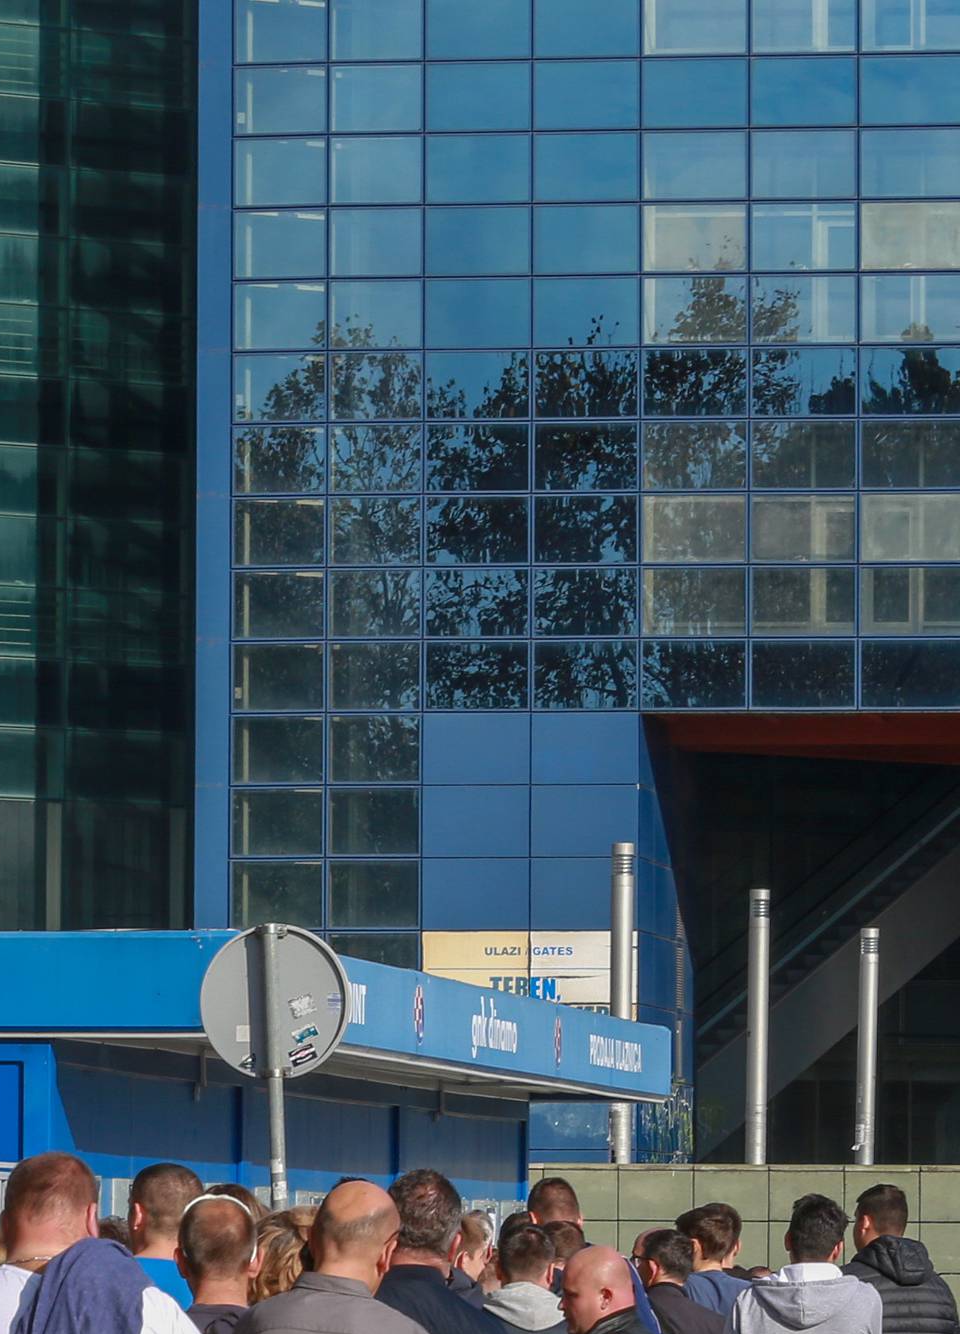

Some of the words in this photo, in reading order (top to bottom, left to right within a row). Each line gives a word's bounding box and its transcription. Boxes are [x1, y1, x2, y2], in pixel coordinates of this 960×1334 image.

[484, 946, 521, 956] ULAZI
[532, 946, 573, 956] GATES
[488, 997, 518, 1054] dinamo
